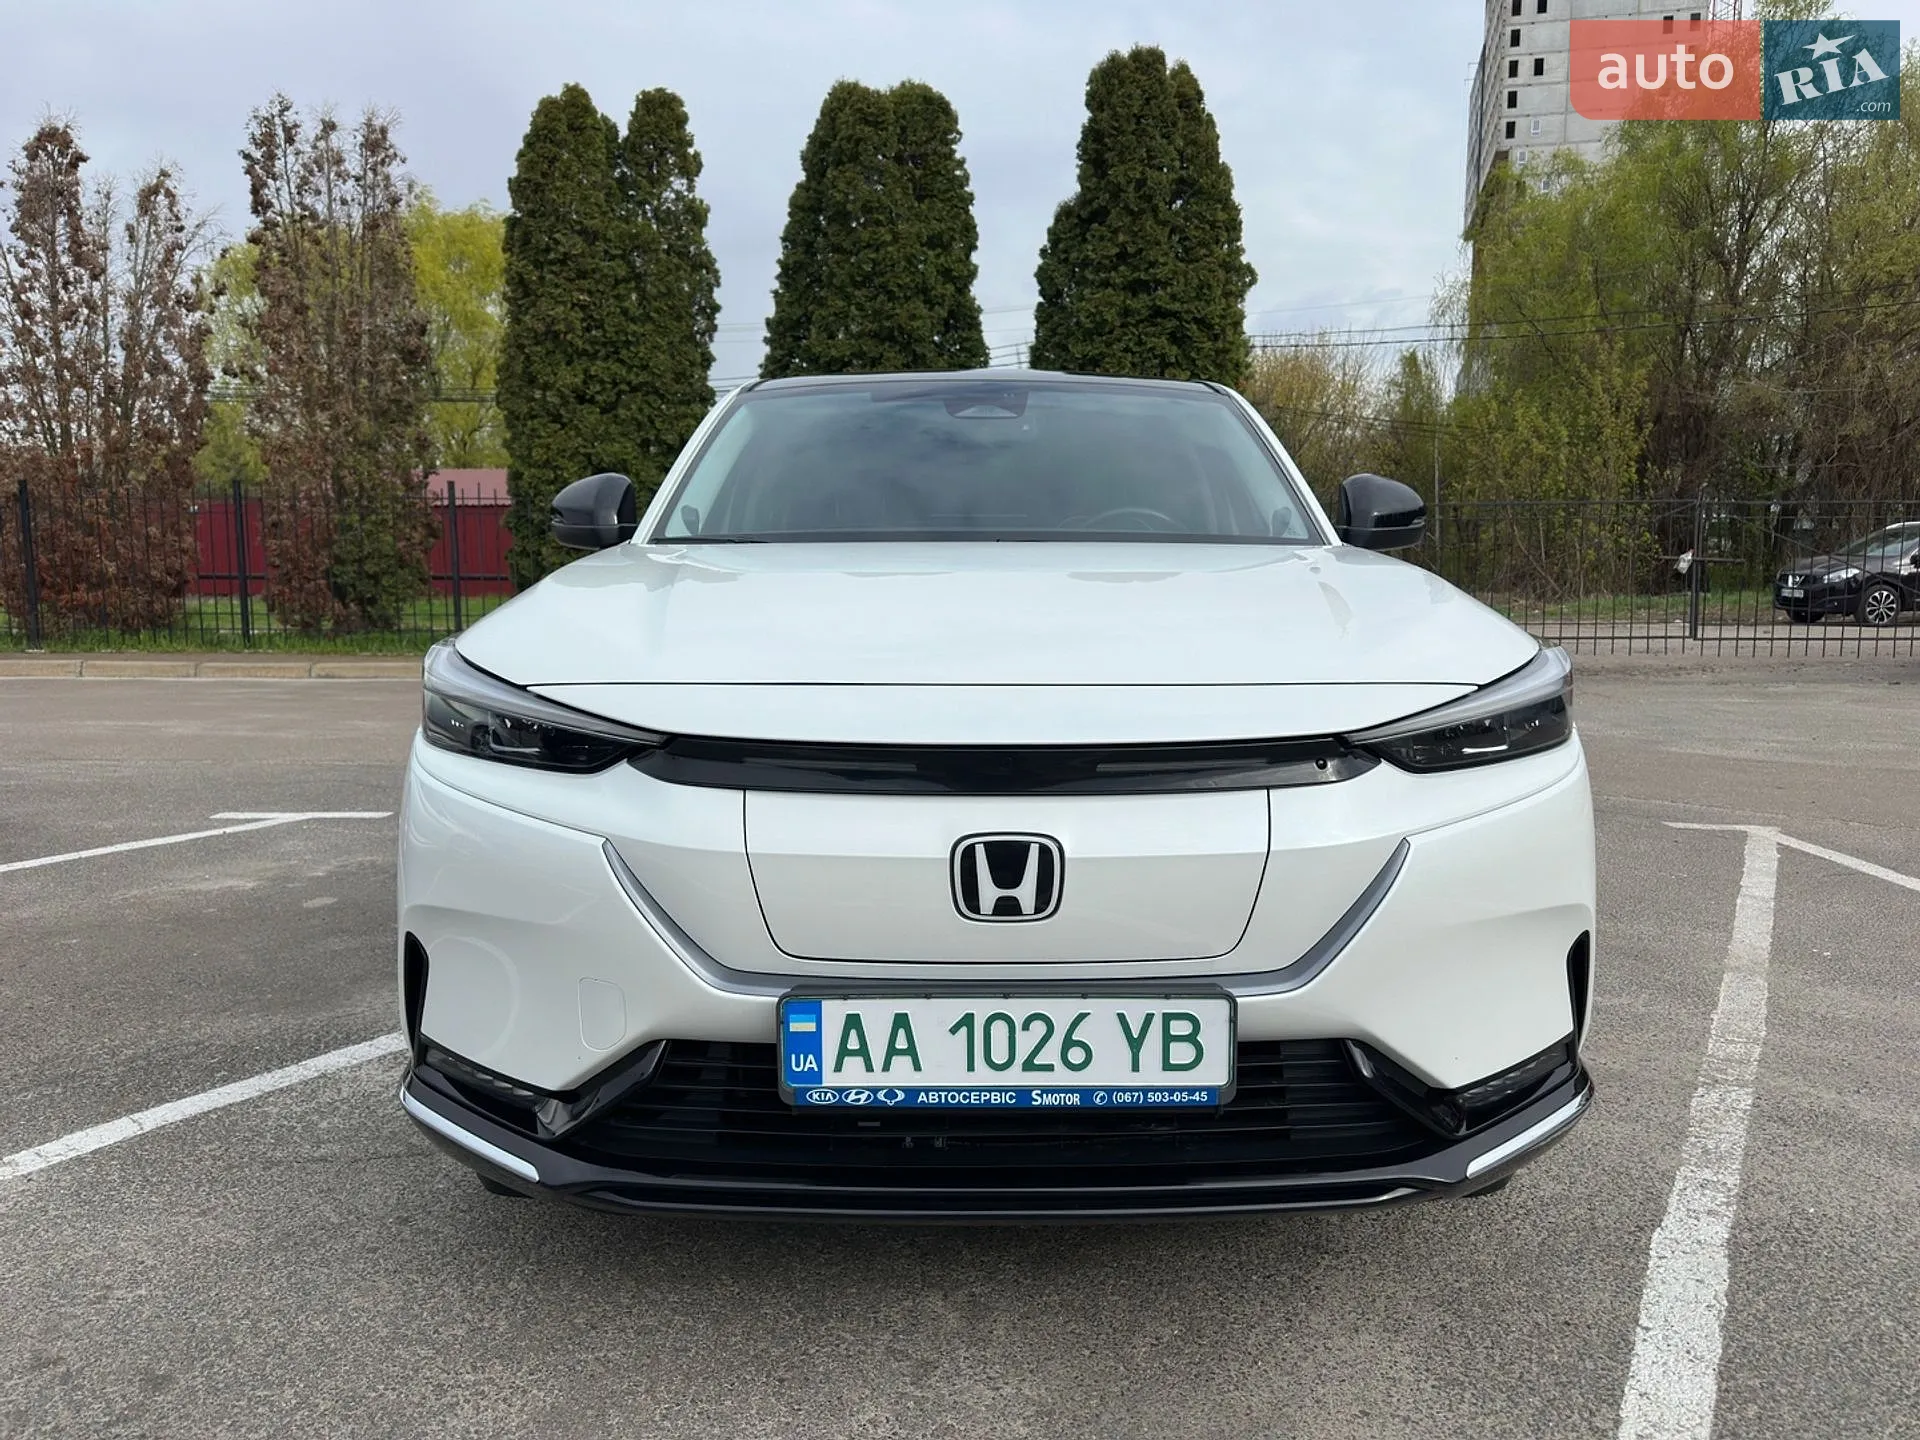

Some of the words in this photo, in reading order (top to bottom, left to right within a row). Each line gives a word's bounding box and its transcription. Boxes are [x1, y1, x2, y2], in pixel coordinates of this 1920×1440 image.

[833, 1012, 922, 1073] AA
[948, 1011, 1094, 1073] 1026
[1116, 1011, 1205, 1073] YB
[790, 1054, 819, 1072] UA
[917, 1091, 1016, 1104] АВТОСЕРВІС
[1112, 1091, 1144, 1104] (067)
[1147, 1091, 1208, 1103] 503-05-45
